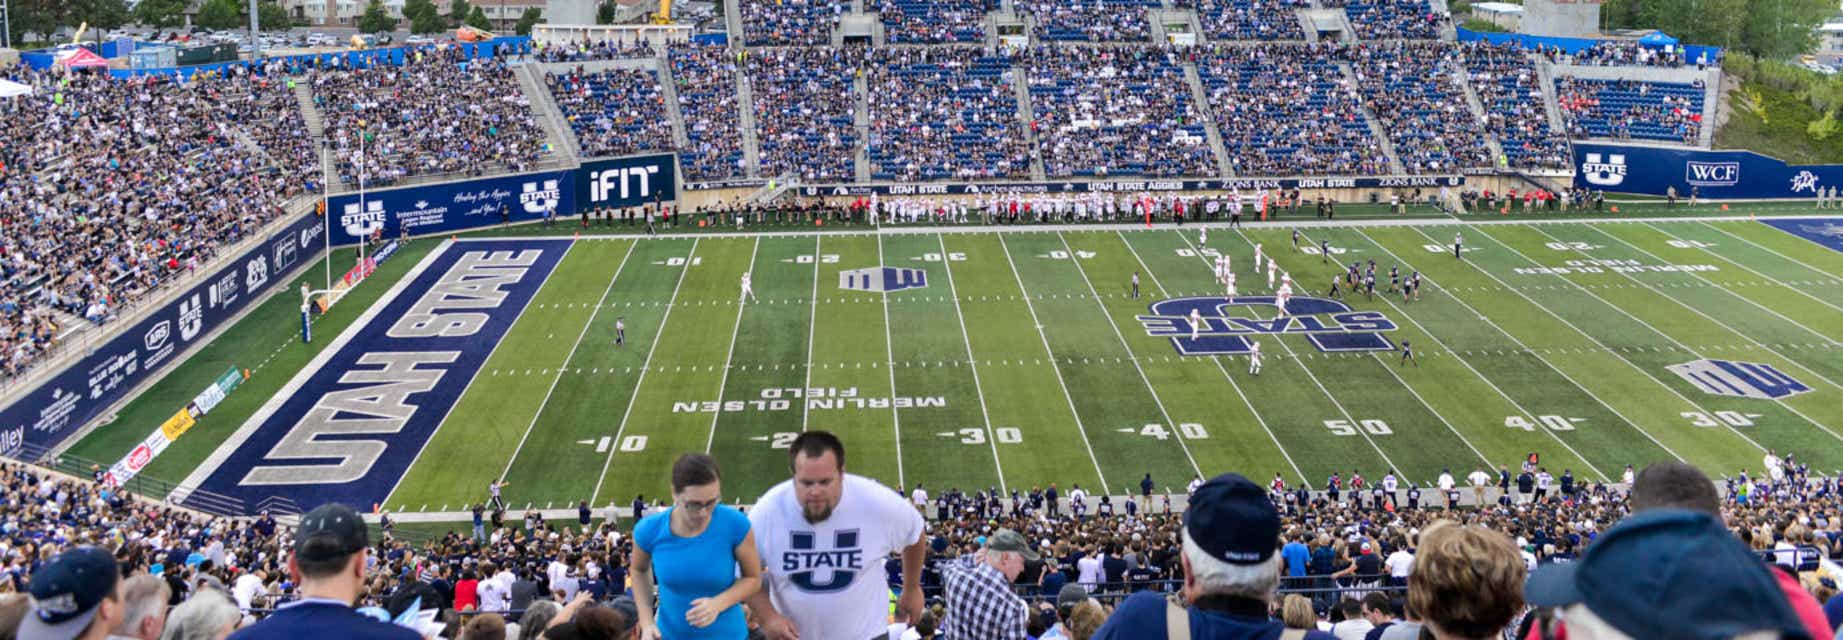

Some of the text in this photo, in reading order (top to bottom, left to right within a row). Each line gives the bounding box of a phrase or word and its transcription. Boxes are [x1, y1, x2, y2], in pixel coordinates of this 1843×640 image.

[1582, 162, 1628, 176] STATE
[1691, 163, 1737, 181] WCF
[590, 165, 659, 202] iFIT
[889, 184, 947, 194] UTAH STATE
[1087, 181, 1183, 191] UTAH STATE AGGIES
[1222, 179, 1281, 189] ZIONS BANK
[1298, 179, 1356, 188] UTAH STATE
[1379, 177, 1438, 187] ZIONS BANK
[519, 189, 560, 205] STATE
[341, 210, 386, 227] STATE
[396, 206, 448, 219] Intermountain
[178, 305, 203, 331] STATE
[1135, 310, 1399, 336] STATE
[237, 248, 544, 487] STATE UTAH
[760, 387, 859, 399] FIELD
[672, 396, 945, 413] MERLIN OLSEN
[1322, 418, 1393, 435] 50
[1503, 414, 1576, 431] 40
[1679, 410, 1756, 427] 30
[0, 424, 24, 454] lley
[771, 431, 799, 449] 2
[959, 426, 1023, 445] 30
[1140, 422, 1209, 441] 40
[595, 435, 648, 453] 10
[782, 549, 863, 571] STATE
[788, 528, 860, 593] U
